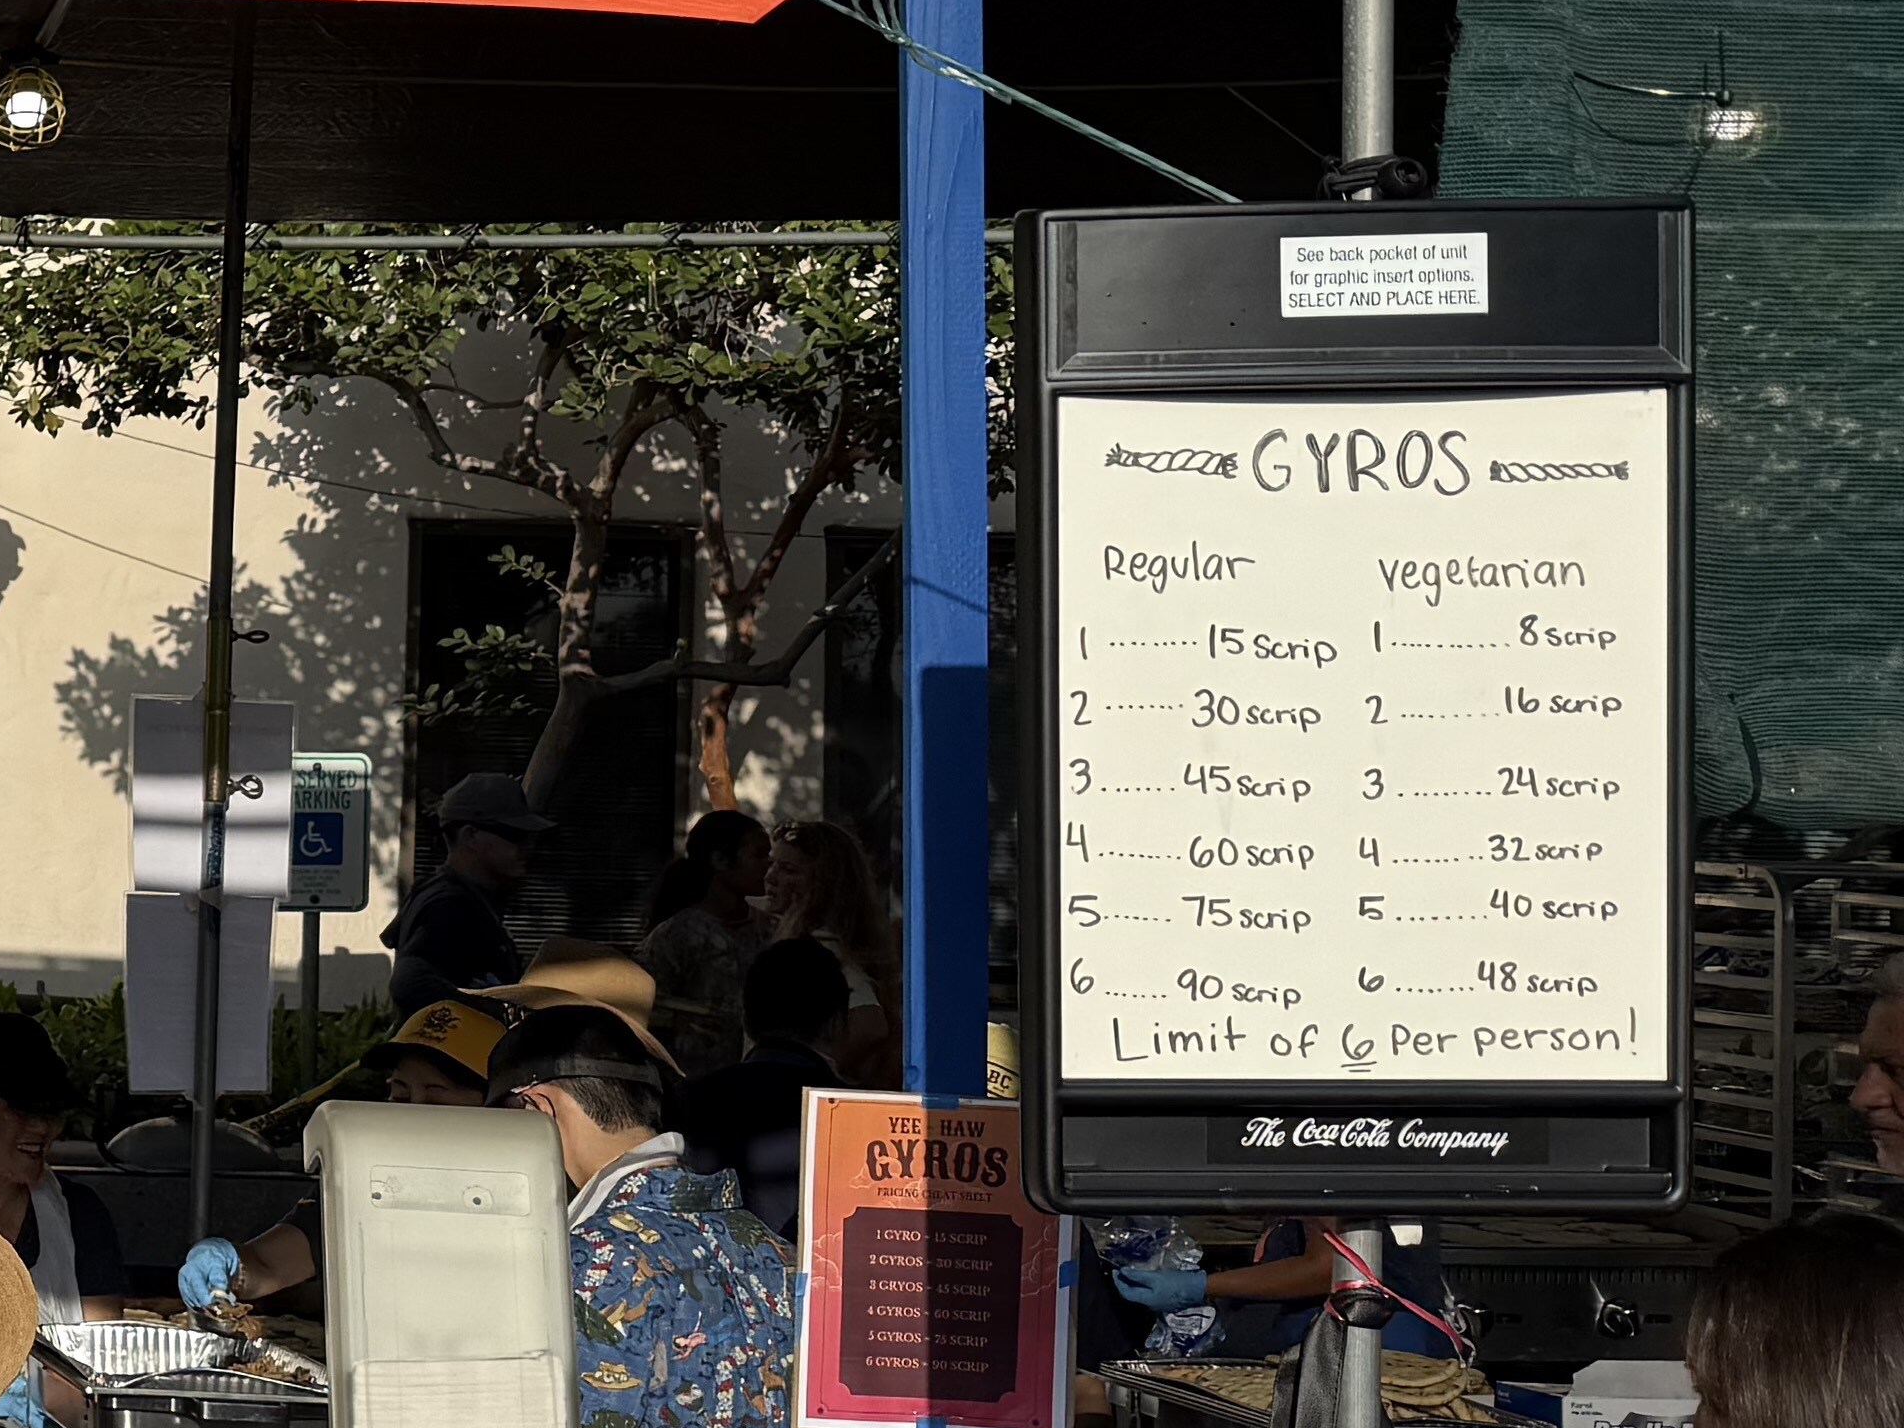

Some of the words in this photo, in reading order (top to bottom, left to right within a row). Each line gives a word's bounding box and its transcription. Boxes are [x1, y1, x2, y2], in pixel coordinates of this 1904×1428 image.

[1296, 247, 1324, 263] See
[1329, 246, 1365, 262] back
[1369, 244, 1418, 264] pocket
[1422, 244, 1437, 260] of
[1441, 244, 1468, 261] unit
[1289, 270, 1308, 286] for
[1314, 269, 1369, 288] graphic
[1373, 268, 1414, 285] insert
[1418, 267, 1475, 285] options.
[1288, 291, 1345, 308] SELECT
[1349, 290, 1382, 307] AND
[1386, 290, 1434, 307] PLACE
[1438, 288, 1481, 305] HERE.
[1251, 428, 1470, 496] GYROS
[1103, 540, 1257, 595] Regular
[1079, 625, 1089, 661] 1
[1209, 623, 1246, 660] 15
[1372, 620, 1382, 653] 1
[1518, 614, 1539, 647] 8
[1544, 627, 1617, 651] scrip
[1069, 689, 1093, 726] 2
[1191, 688, 1242, 728] 30
[1245, 703, 1322, 734] scrip
[1364, 694, 1389, 725] 2
[1504, 685, 1540, 715] 16
[1548, 694, 1623, 719] scrip
[294, 769, 358, 790] SERVED
[1068, 757, 1093, 796] 3
[1183, 762, 1233, 795] 45
[1236, 774, 1312, 804] scrip
[1361, 767, 1386, 801] 3
[1496, 765, 1541, 798] 24
[1545, 776, 1622, 802] scrip
[294, 791, 352, 810] ARKING
[1065, 821, 1090, 864] 4
[1188, 835, 1240, 869] 60
[1245, 843, 1315, 871] scrip
[1358, 835, 1380, 868] 4
[1487, 833, 1531, 863] 32
[1534, 840, 1604, 862] scrip
[1067, 893, 1102, 928] 5
[1180, 894, 1234, 927] 75
[1239, 907, 1312, 935] scrip
[1357, 894, 1386, 921] 5
[1489, 887, 1533, 920] 40
[1541, 899, 1619, 922] scrip
[1069, 956, 1095, 995] 6
[1176, 967, 1224, 1002] 90
[1230, 982, 1302, 1011] scrip
[1357, 965, 1386, 994] 6
[1476, 959, 1519, 993] 48
[1526, 972, 1599, 998] scrip
[1111, 1015, 1248, 1063] Limit
[1268, 1024, 1320, 1060] of
[1340, 1022, 1378, 1060] 6
[1472, 1005, 1640, 1060] person!
[988, 1070, 1011, 1092] BC
[888, 1116, 922, 1135] YEE
[940, 1119, 986, 1138] HAW
[1240, 1117, 1287, 1148] The
[1290, 1115, 1393, 1149] Coca-Cola
[1395, 1117, 1510, 1158] Company
[866, 1138, 1009, 1188] GYROS
[877, 1187, 919, 1199] PRICING
[884, 1229, 922, 1243] GYRO
[949, 1232, 988, 1246] SCRIP
[879, 1254, 924, 1268] GYROS
[955, 1259, 993, 1271] SCRIP
[878, 1280, 924, 1293] GRYOS
[953, 1284, 991, 1297] SCRIP
[876, 1305, 922, 1319] GYROS
[953, 1309, 992, 1322] SCRIP
[877, 1330, 922, 1344] GYROS
[950, 1335, 989, 1348] SCRIP
[875, 1356, 920, 1369] GYROS
[951, 1360, 990, 1374] SCRIP
